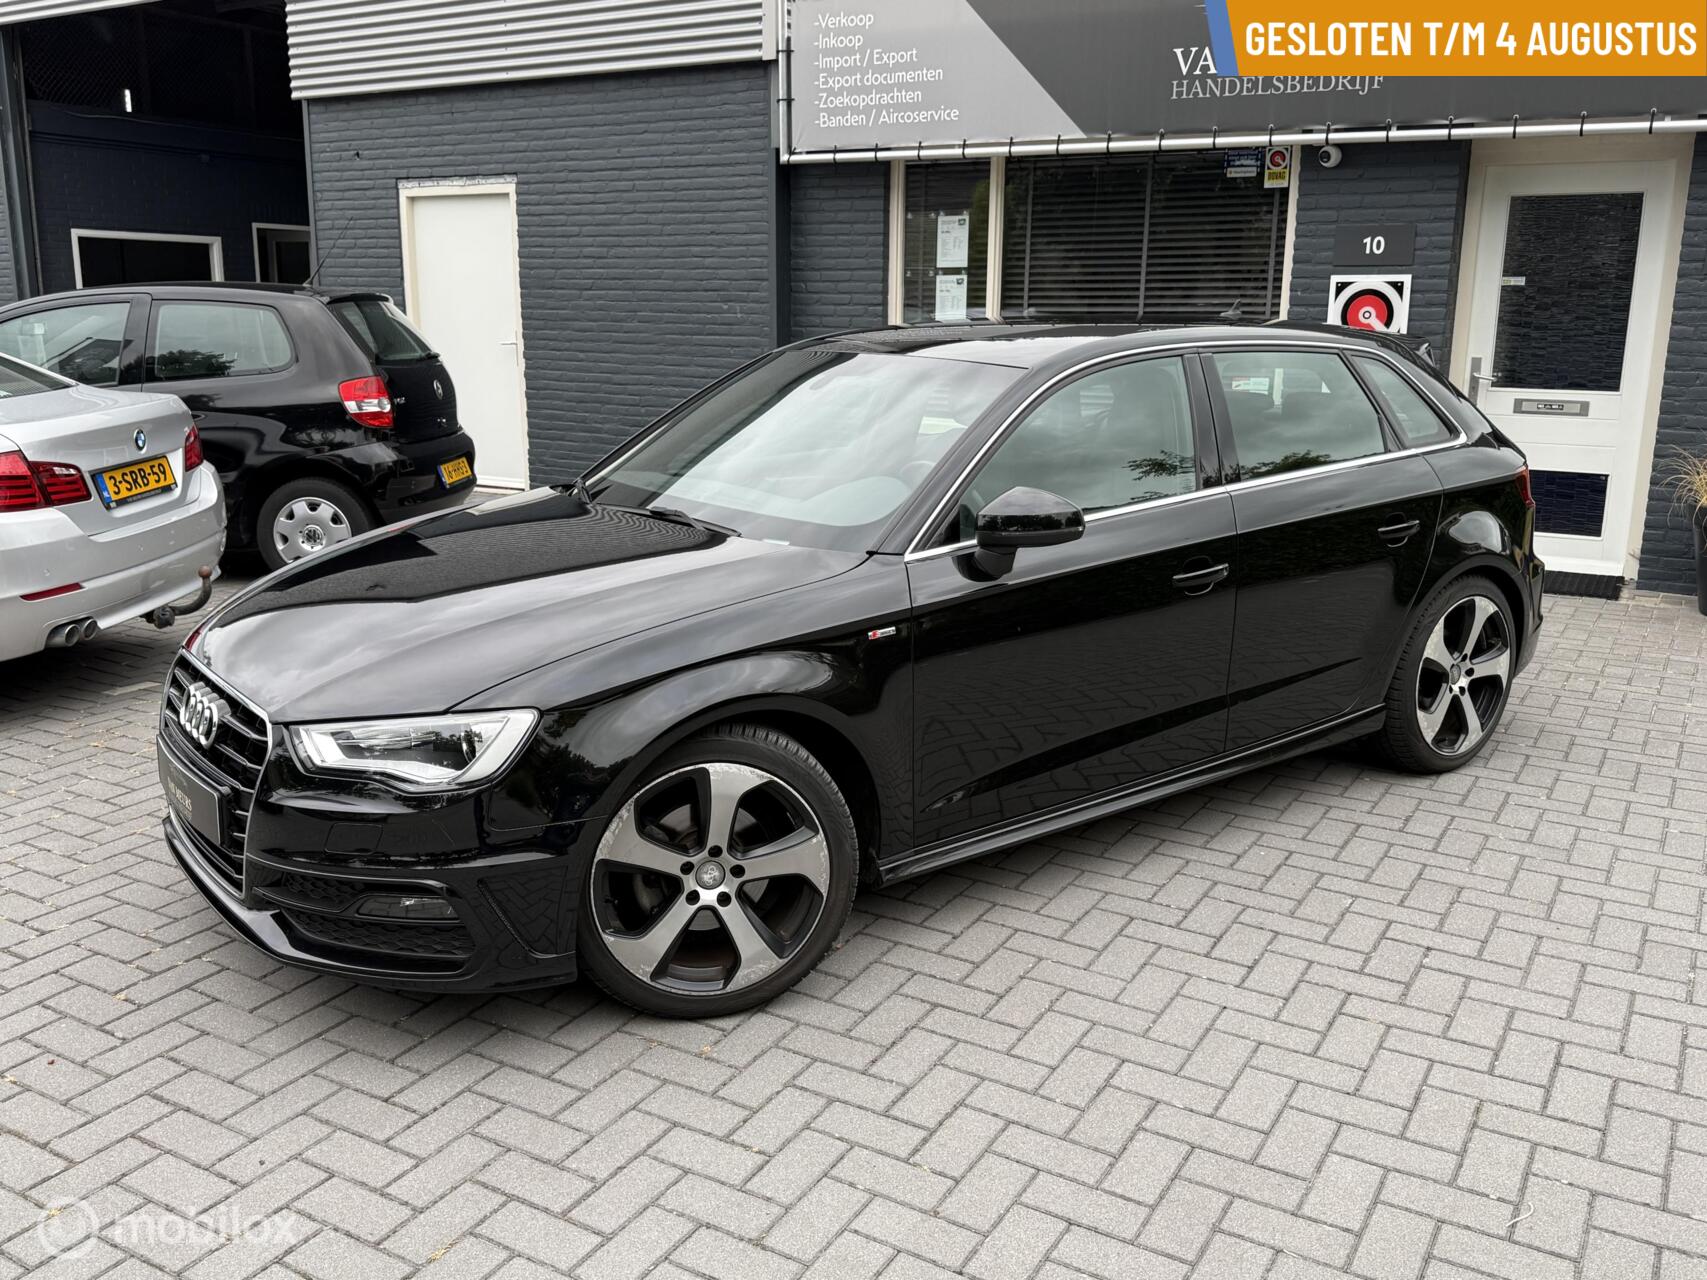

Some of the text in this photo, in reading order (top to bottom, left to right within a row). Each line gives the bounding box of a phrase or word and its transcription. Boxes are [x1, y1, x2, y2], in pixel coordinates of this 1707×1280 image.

[814, 12, 874, 29] -Verkoop
[814, 33, 864, 50] -Inkoop
[814, 48, 918, 70] -Import / Export
[1173, 46, 1217, 76] VA
[814, 68, 943, 91] -Export documenten
[1170, 76, 1384, 100] HANDELSBEDRIJF
[814, 89, 922, 109] -Zoekopdrachten
[814, 106, 960, 128] -Banden / Aircoservice
[1363, 235, 1385, 254] 10
[109, 463, 167, 495] 3-SRB-59
